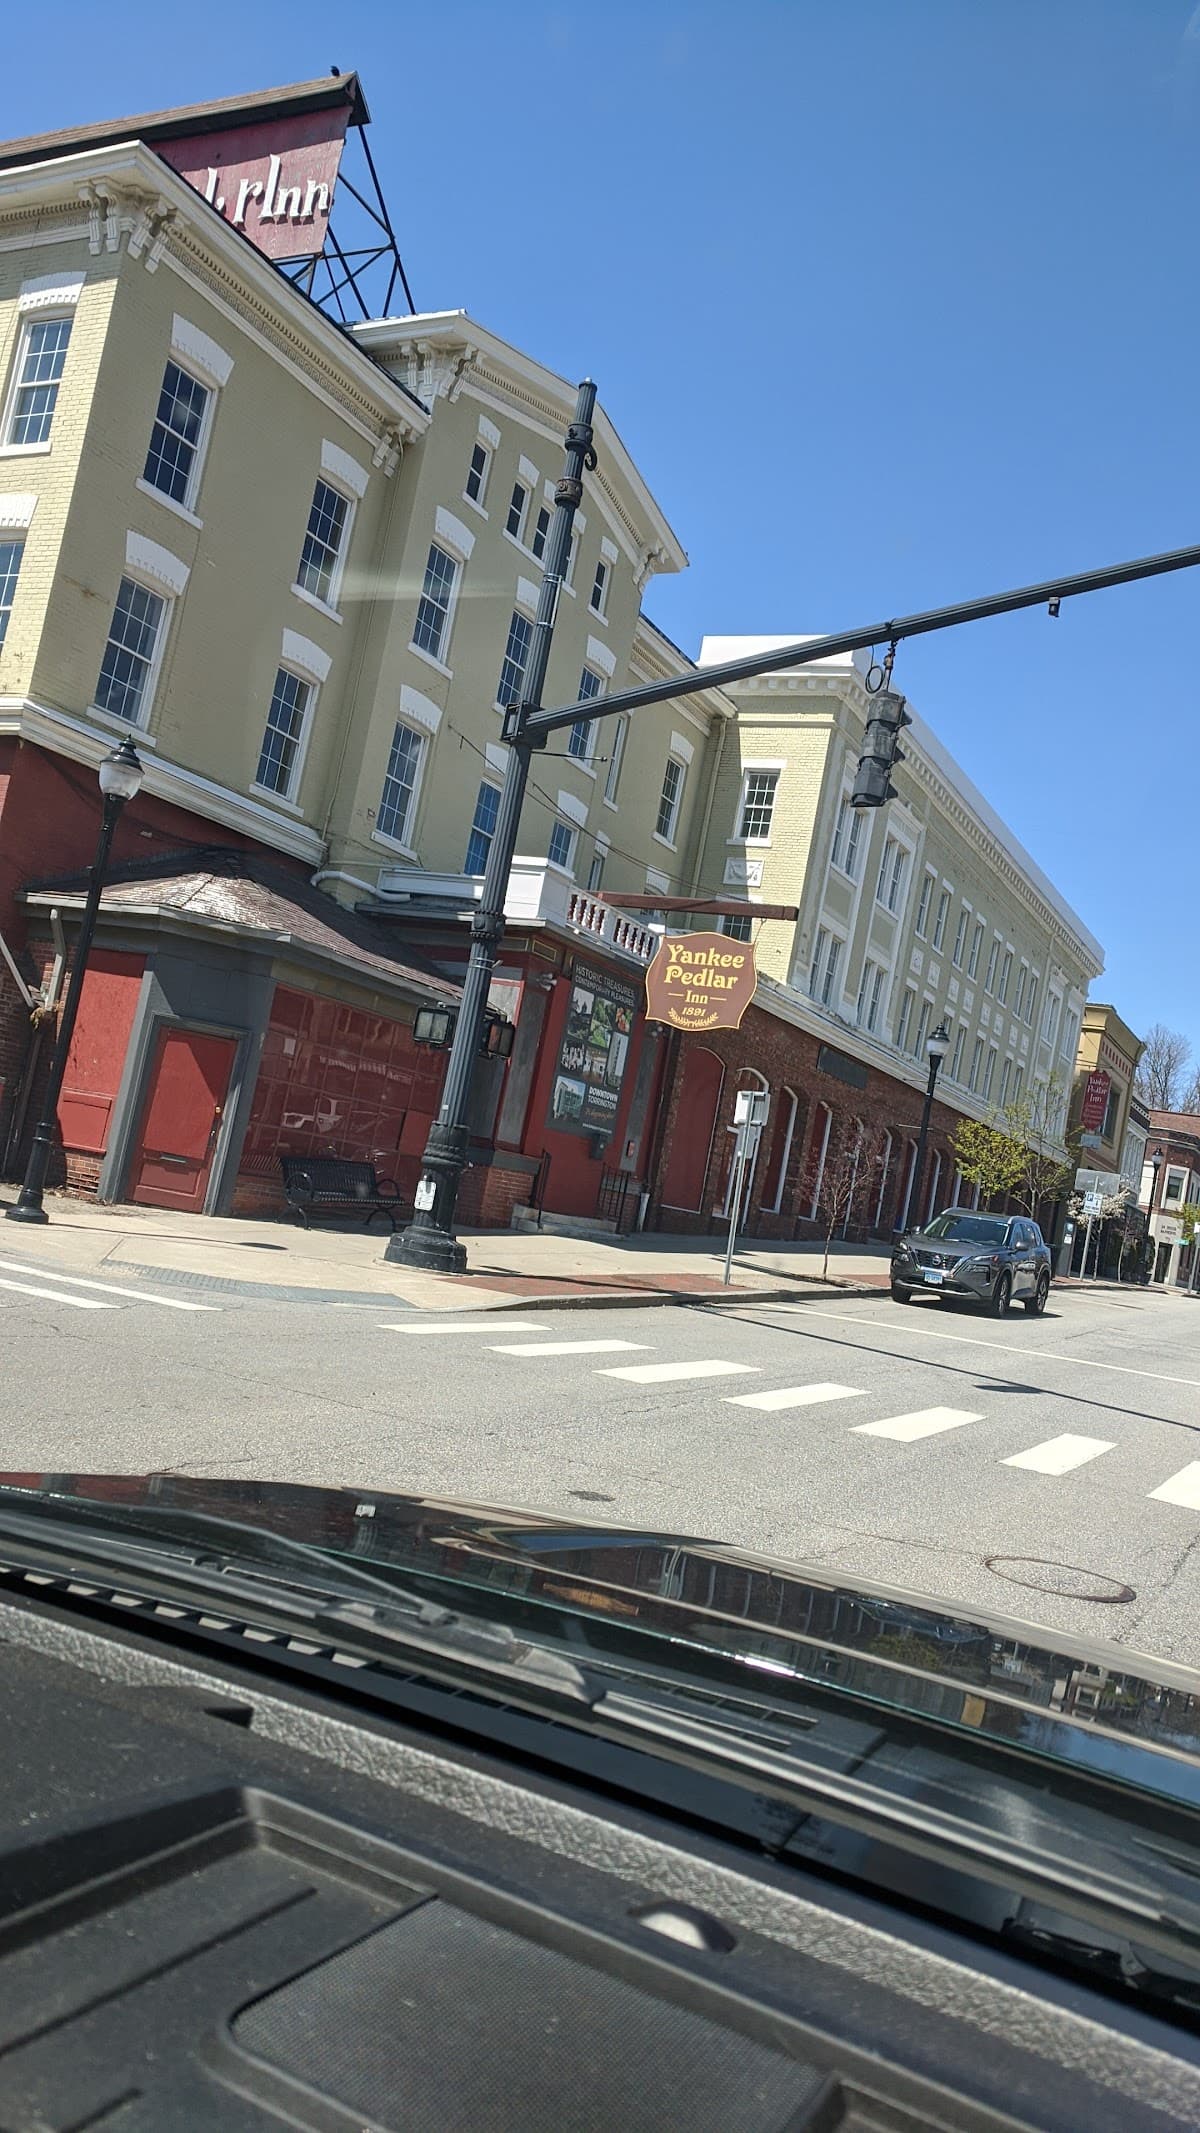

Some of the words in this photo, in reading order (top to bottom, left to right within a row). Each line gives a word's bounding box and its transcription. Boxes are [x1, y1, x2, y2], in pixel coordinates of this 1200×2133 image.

[258, 153, 329, 219] Inn
[667, 944, 745, 968] Yankee
[576, 964, 602, 984] HISTORIC
[664, 965, 738, 989] Pedlar
[685, 990, 708, 1004] Inn
[682, 1007, 706, 1017] 1891
[588, 1095, 617, 1110] TORRINGTON
[589, 1086, 618, 1103] DOWNTOWN
